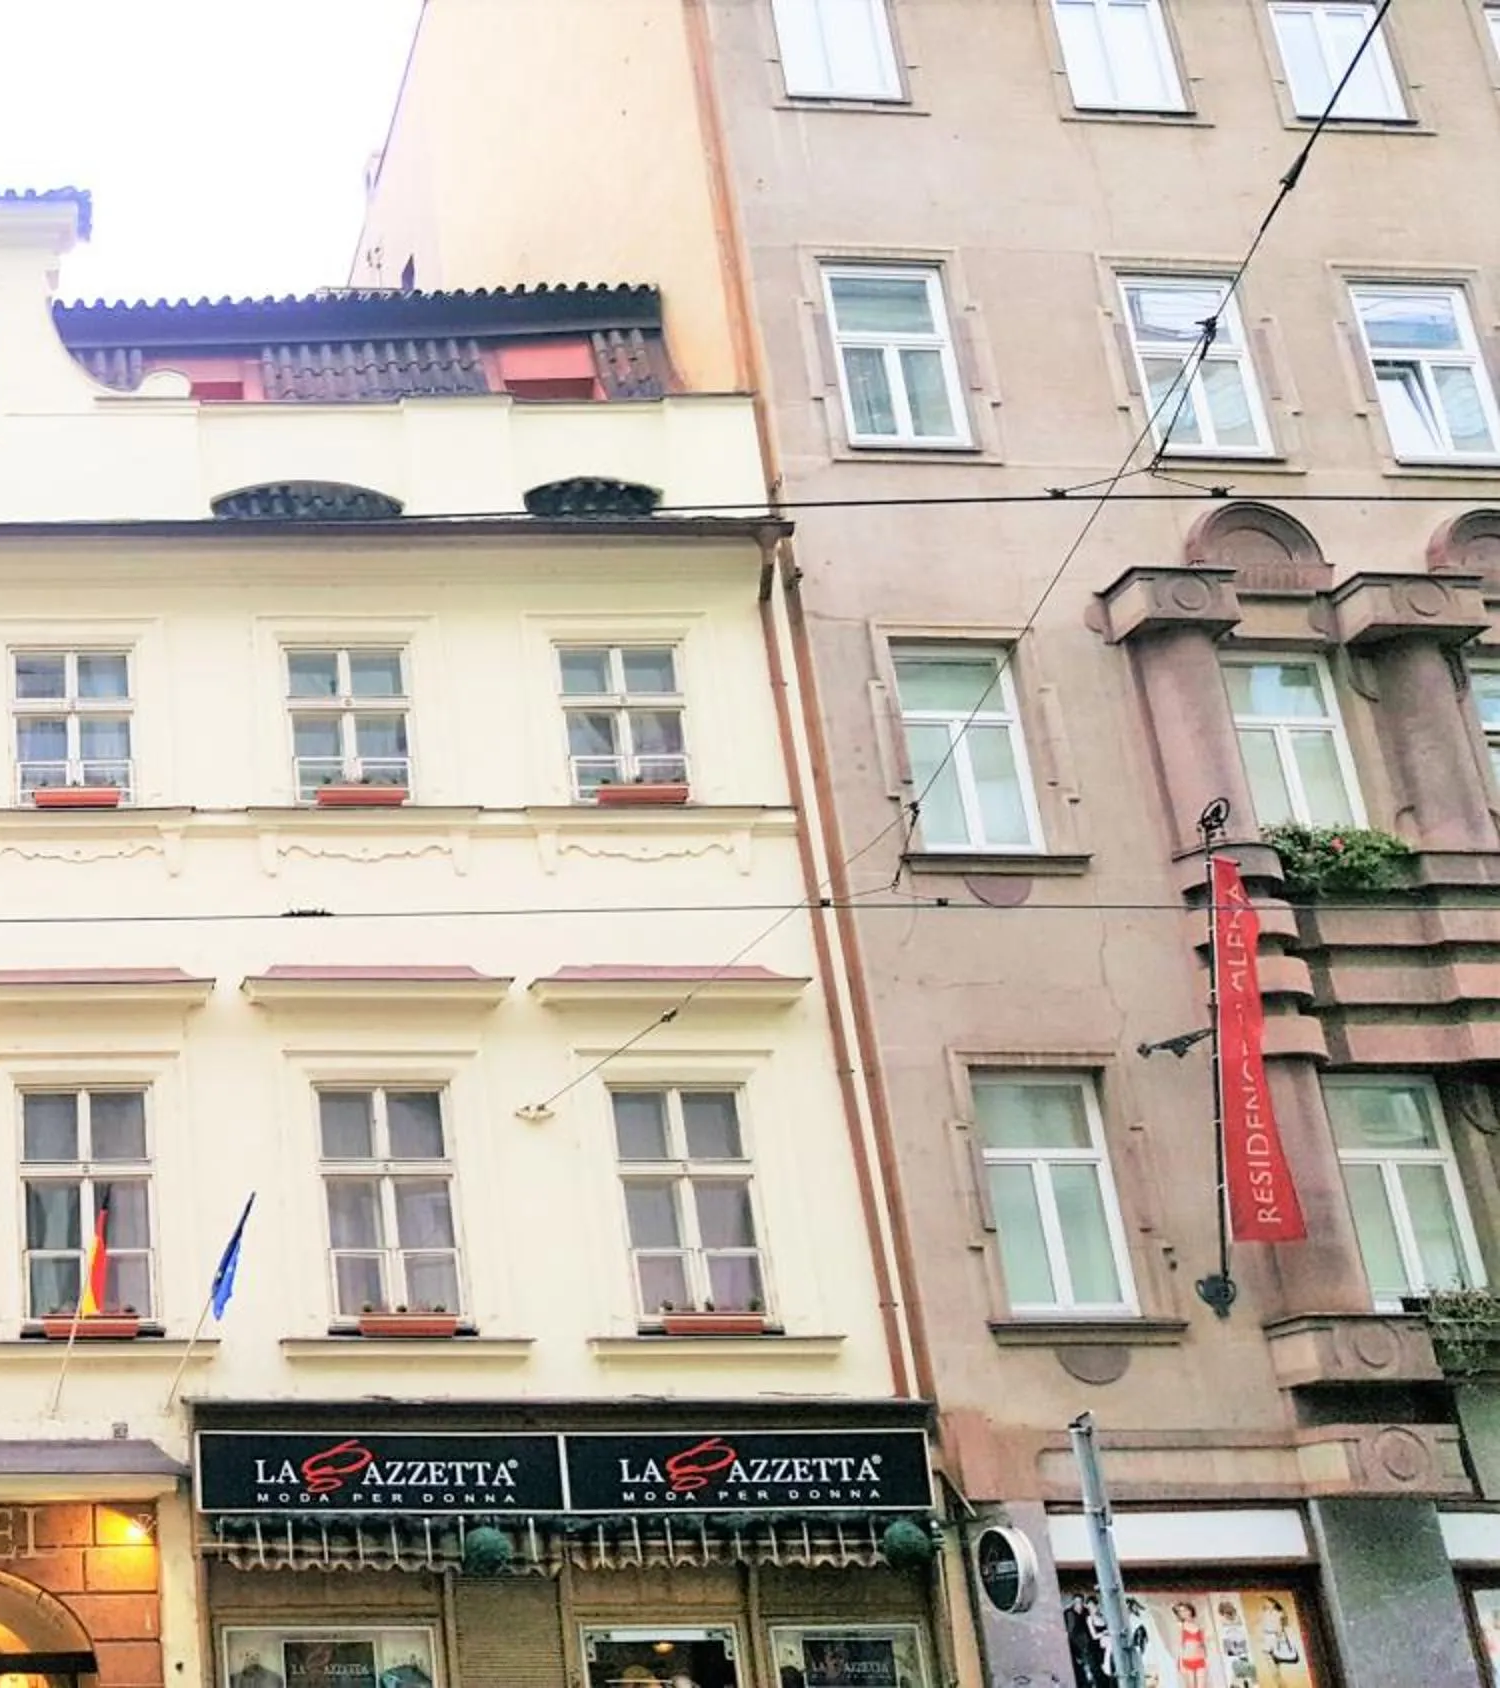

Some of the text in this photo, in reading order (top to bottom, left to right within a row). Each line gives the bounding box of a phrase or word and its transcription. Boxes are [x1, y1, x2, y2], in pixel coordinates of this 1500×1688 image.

[1242, 1039, 1282, 1223] RESIDEN
[257, 1493, 516, 1503] MODA PER DONNA
[623, 1488, 881, 1501] MODA PER DONNA
